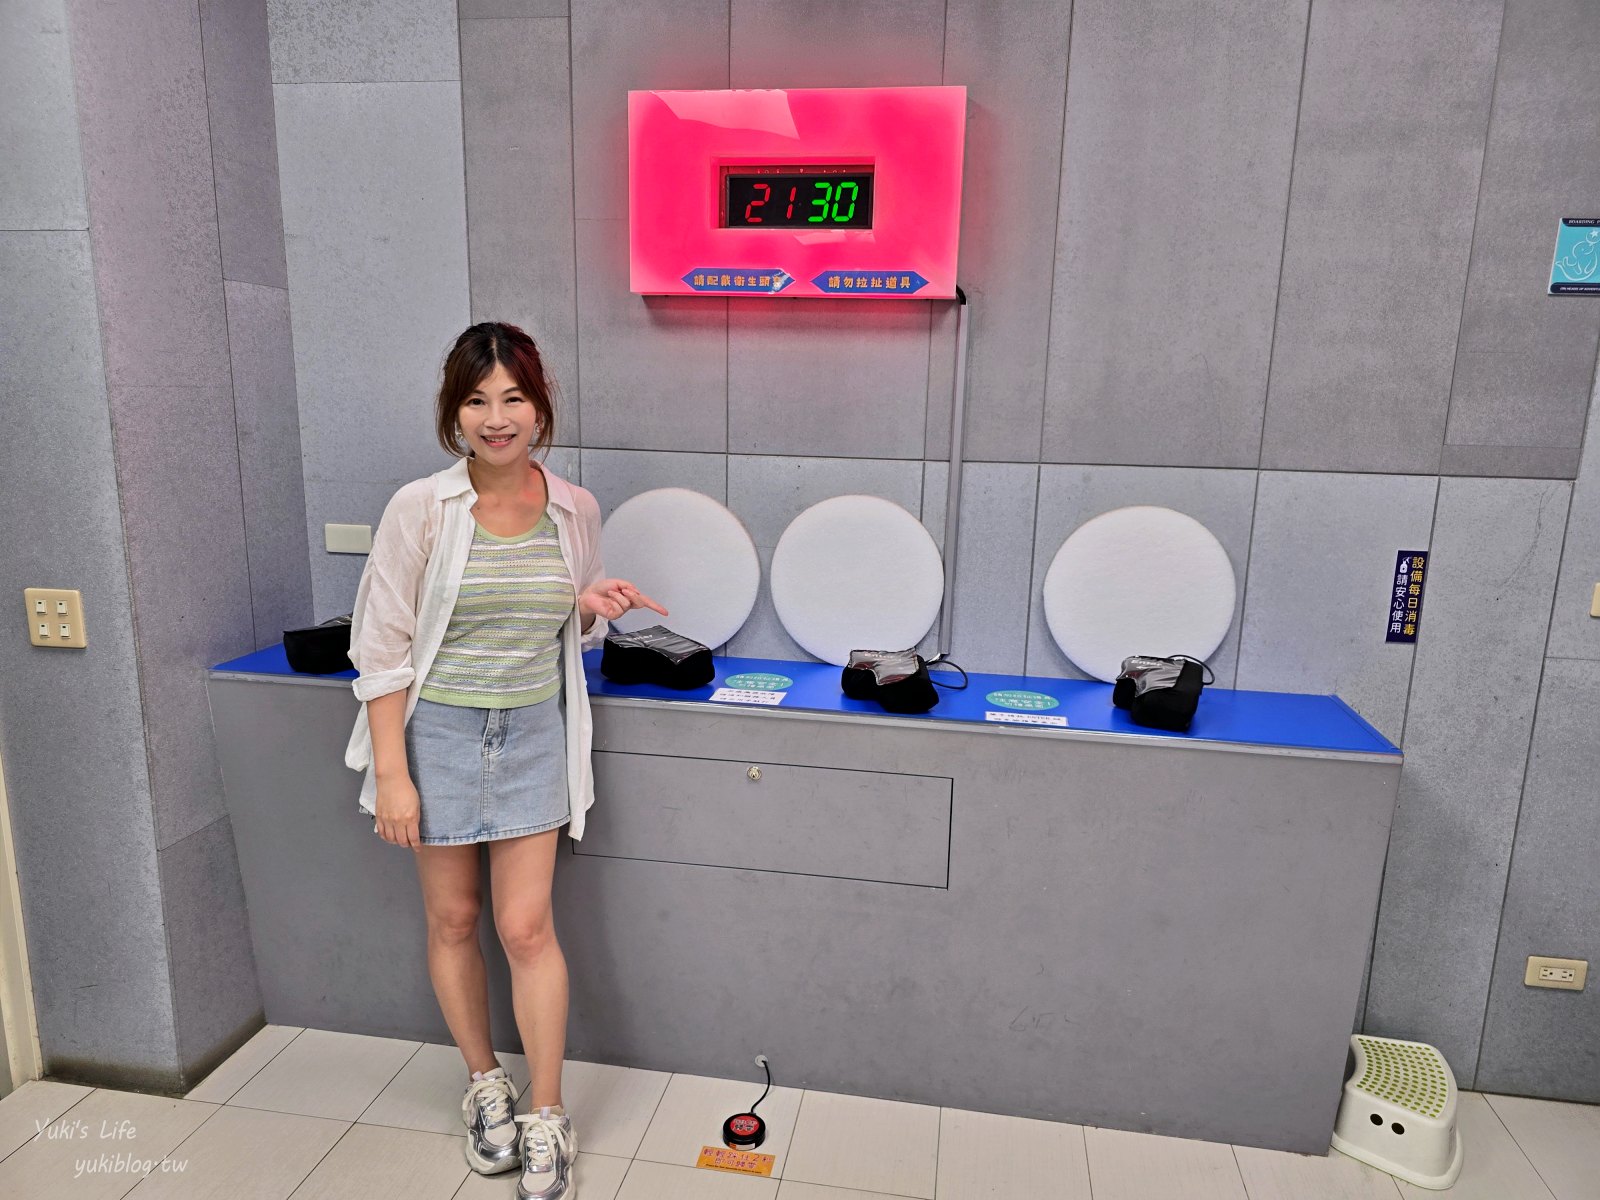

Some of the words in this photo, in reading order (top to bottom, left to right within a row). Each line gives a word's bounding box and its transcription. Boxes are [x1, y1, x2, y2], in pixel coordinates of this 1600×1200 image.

[744, 183, 797, 223] 21
[807, 181, 859, 223] 30
[828, 276, 911, 289] 請勿拉扯道具
[1389, 574, 1409, 634] 請安心使用
[1402, 556, 1425, 636] 設備每日消毒
